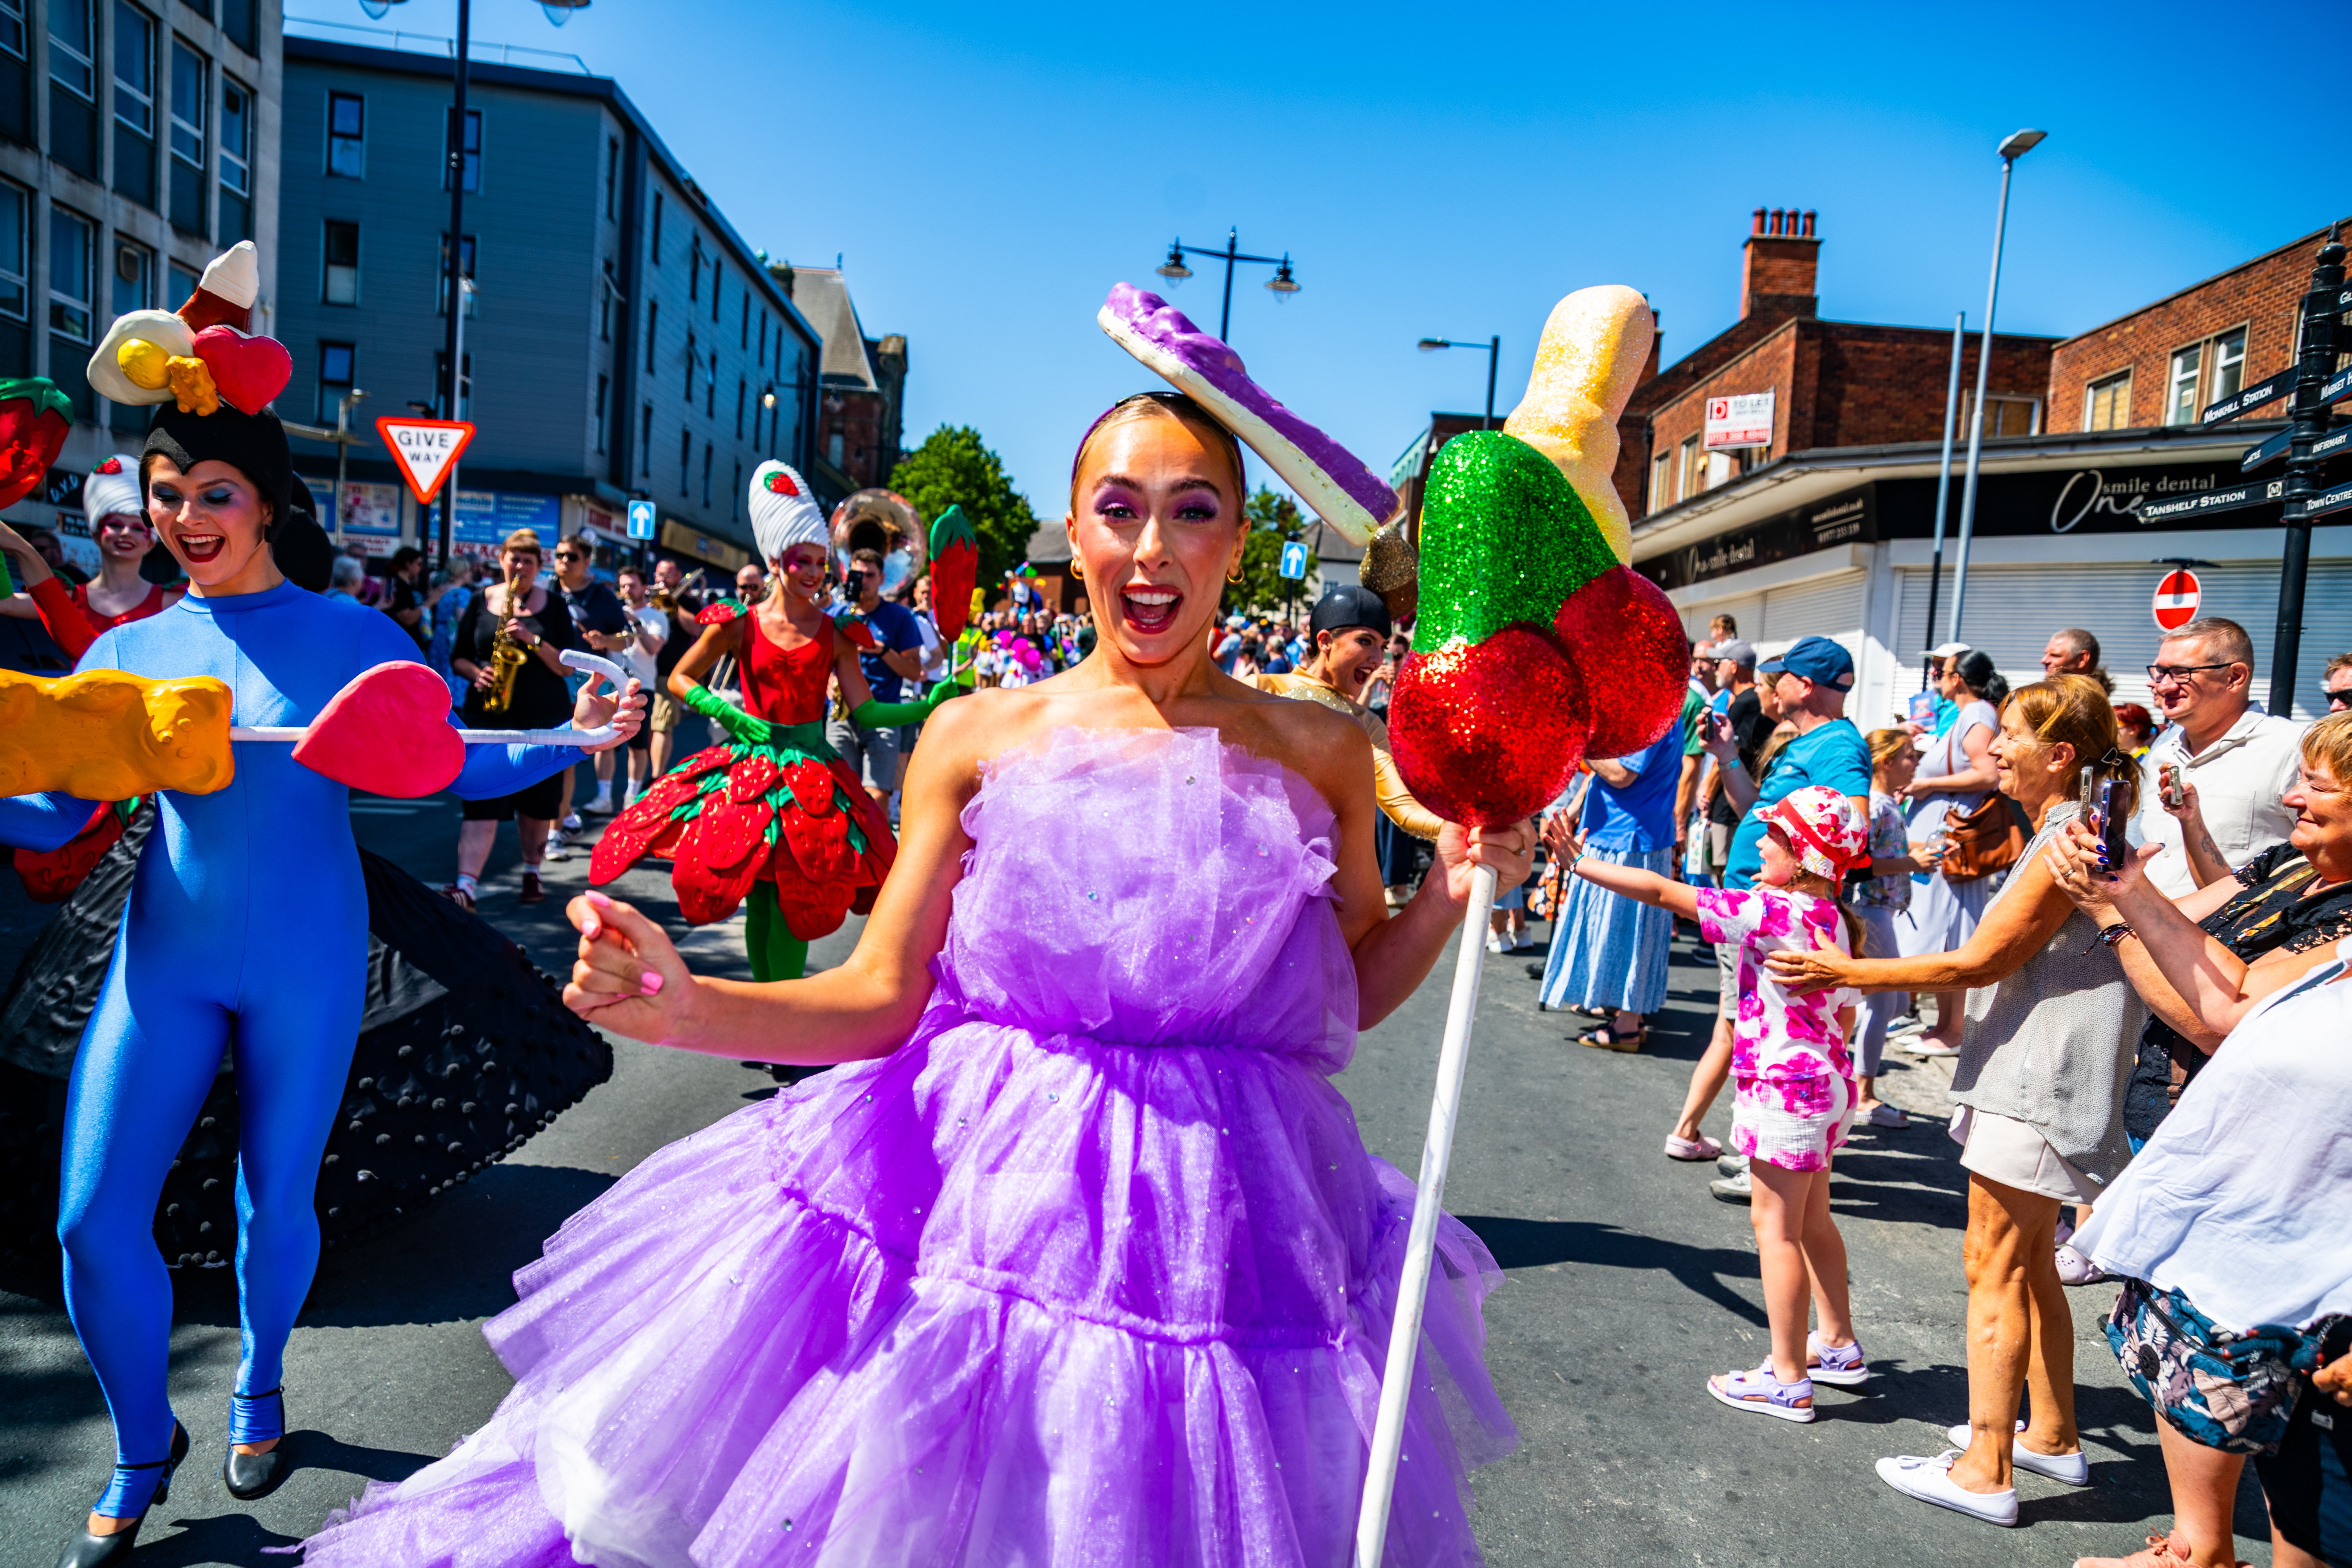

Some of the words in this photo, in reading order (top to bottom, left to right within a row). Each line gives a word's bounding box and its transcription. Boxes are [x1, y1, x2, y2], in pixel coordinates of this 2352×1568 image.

[2320, 377, 2346, 400] MARKET
[2204, 401, 2239, 424] MONKHILL
[2242, 384, 2273, 406] STATION
[398, 430, 449, 448] GIVE
[2312, 433, 2347, 453] INFIRMARY
[409, 452, 441, 462] WAY
[2102, 478, 2150, 494] smile
[2156, 473, 2216, 492] dental
[2050, 469, 2144, 533] One
[2145, 499, 2198, 517] TANSHELF
[2200, 490, 2246, 507] STATION
[2307, 497, 2325, 510] TOWN
[2325, 490, 2352, 506] CENTRE
[1709, 547, 1728, 570] smile
[1729, 537, 1755, 565] dental
